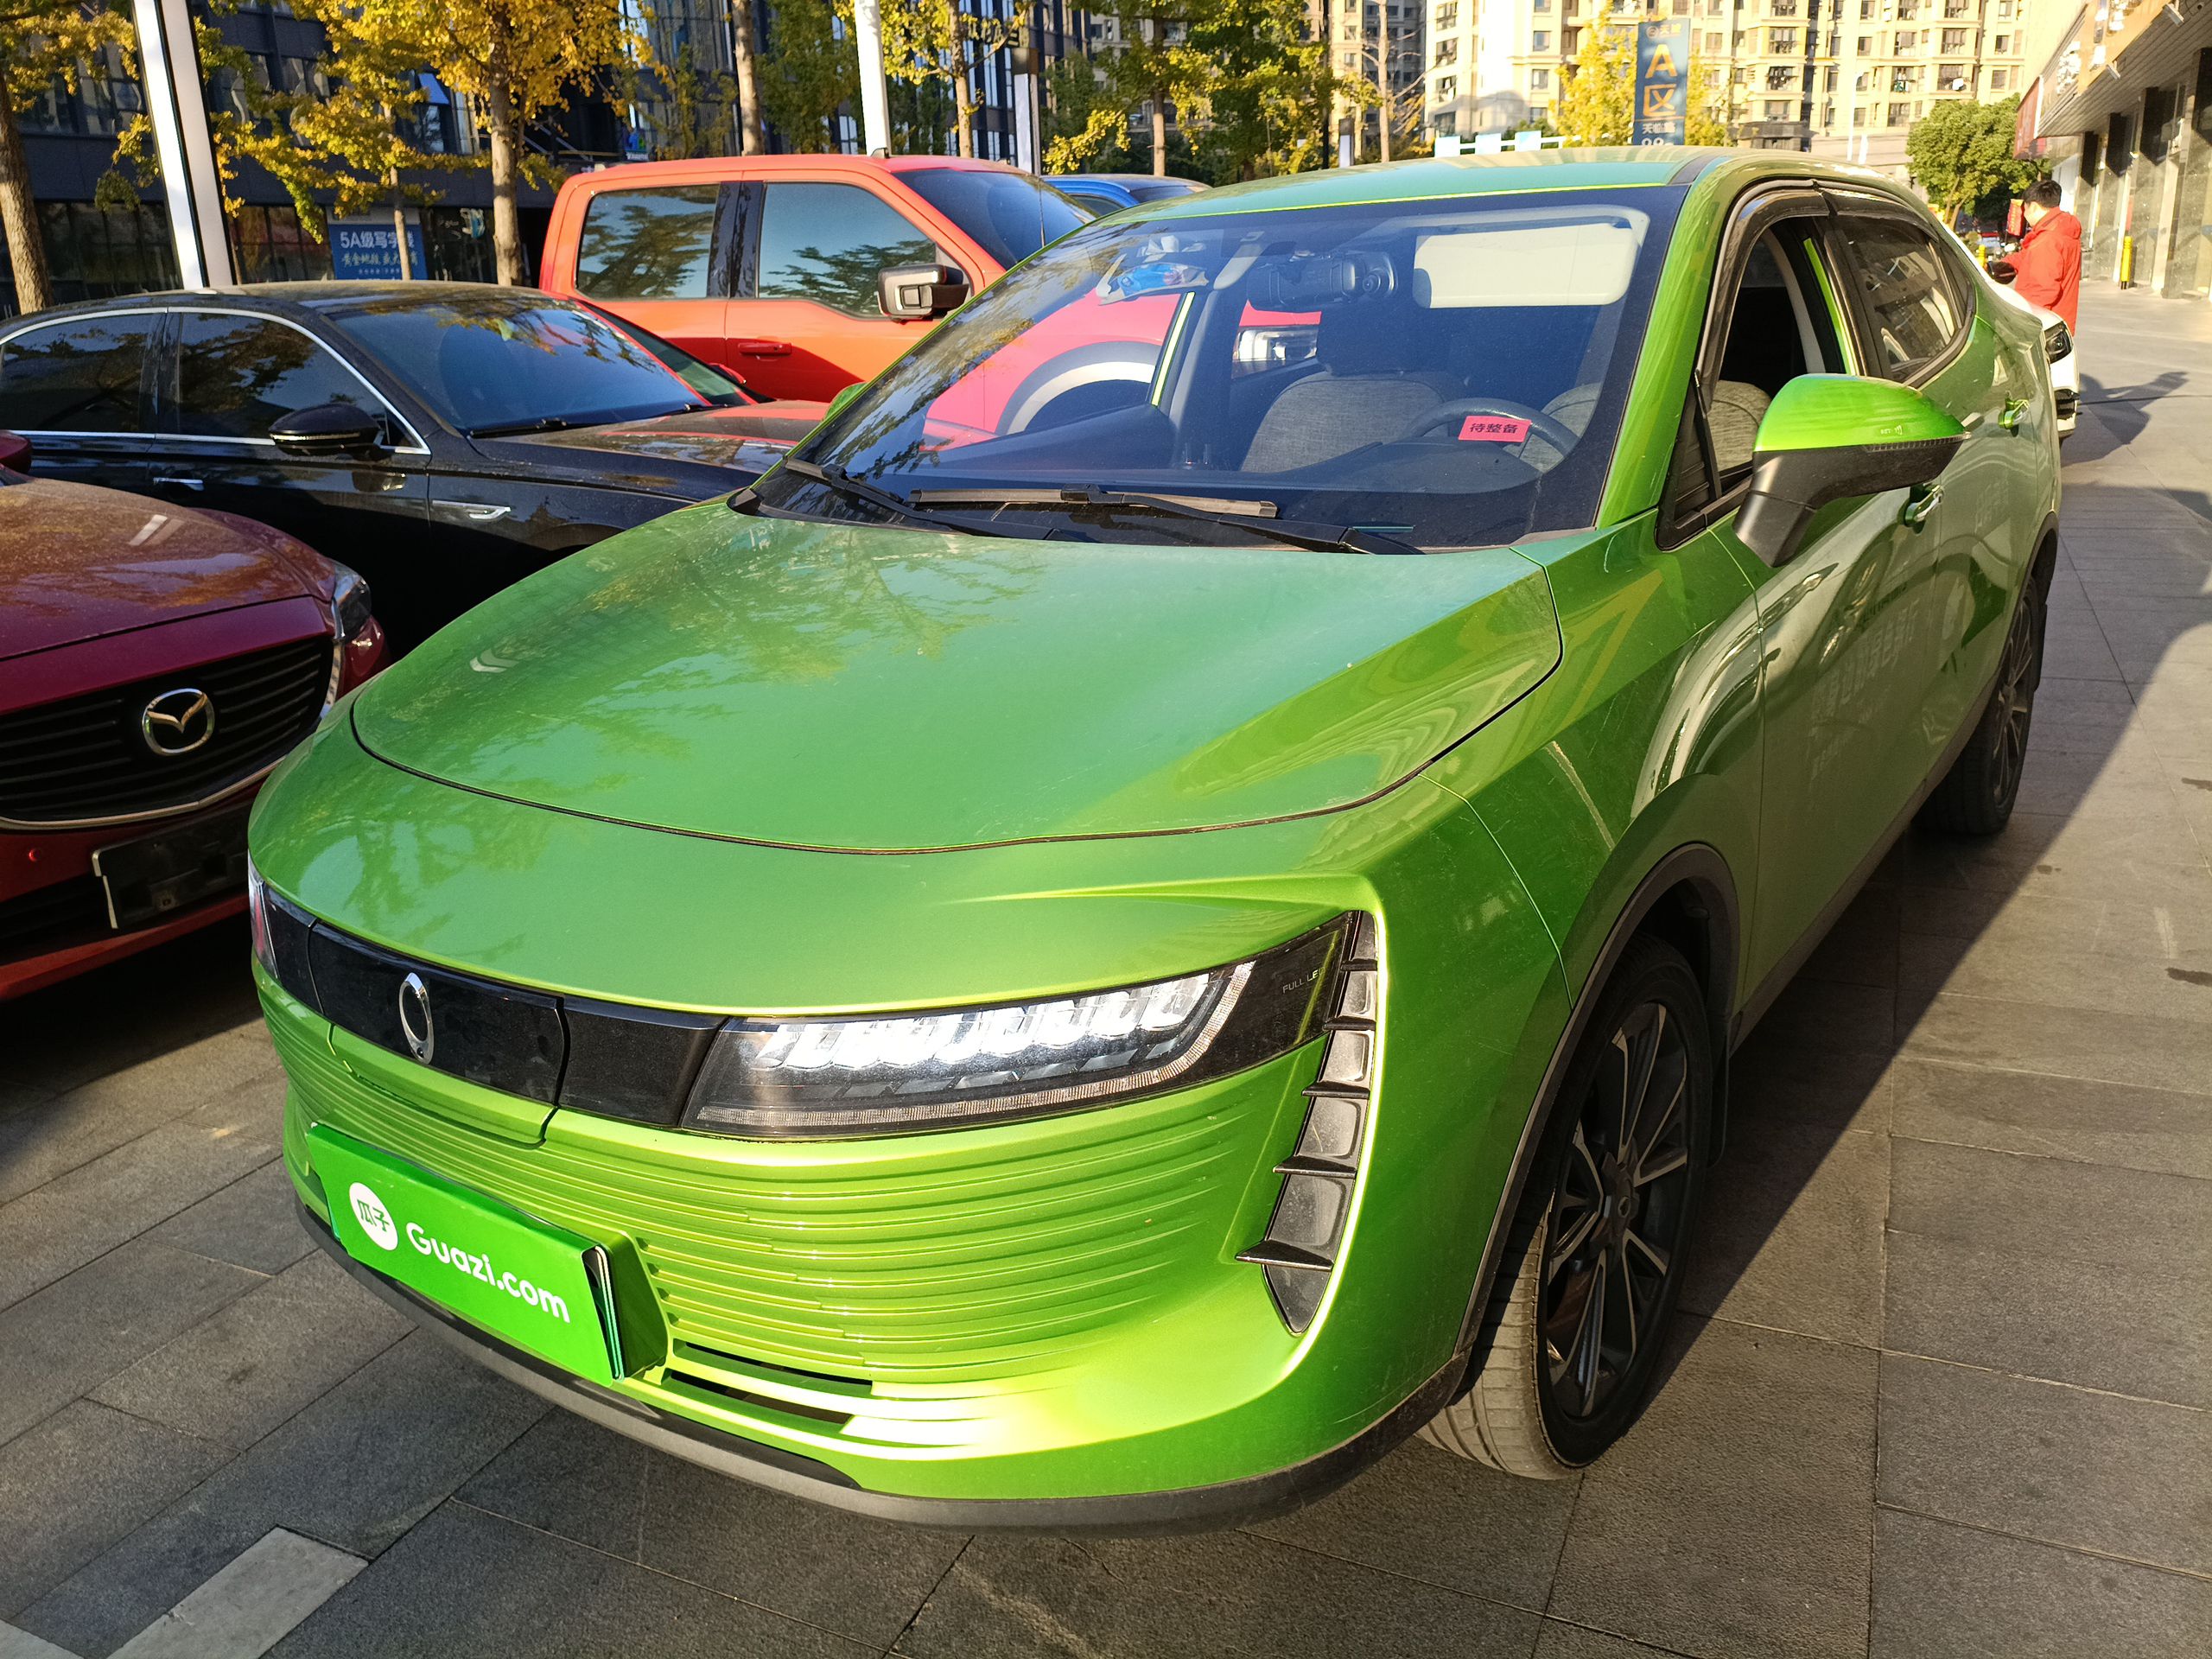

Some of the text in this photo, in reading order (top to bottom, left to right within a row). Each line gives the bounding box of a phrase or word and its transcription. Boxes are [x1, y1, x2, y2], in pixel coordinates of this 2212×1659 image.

[1470, 423, 1517, 434] 待整备
[1282, 978, 1305, 994] FULL
[357, 1199, 390, 1233] 瓜子
[406, 1223, 570, 1323] Guazi.com
